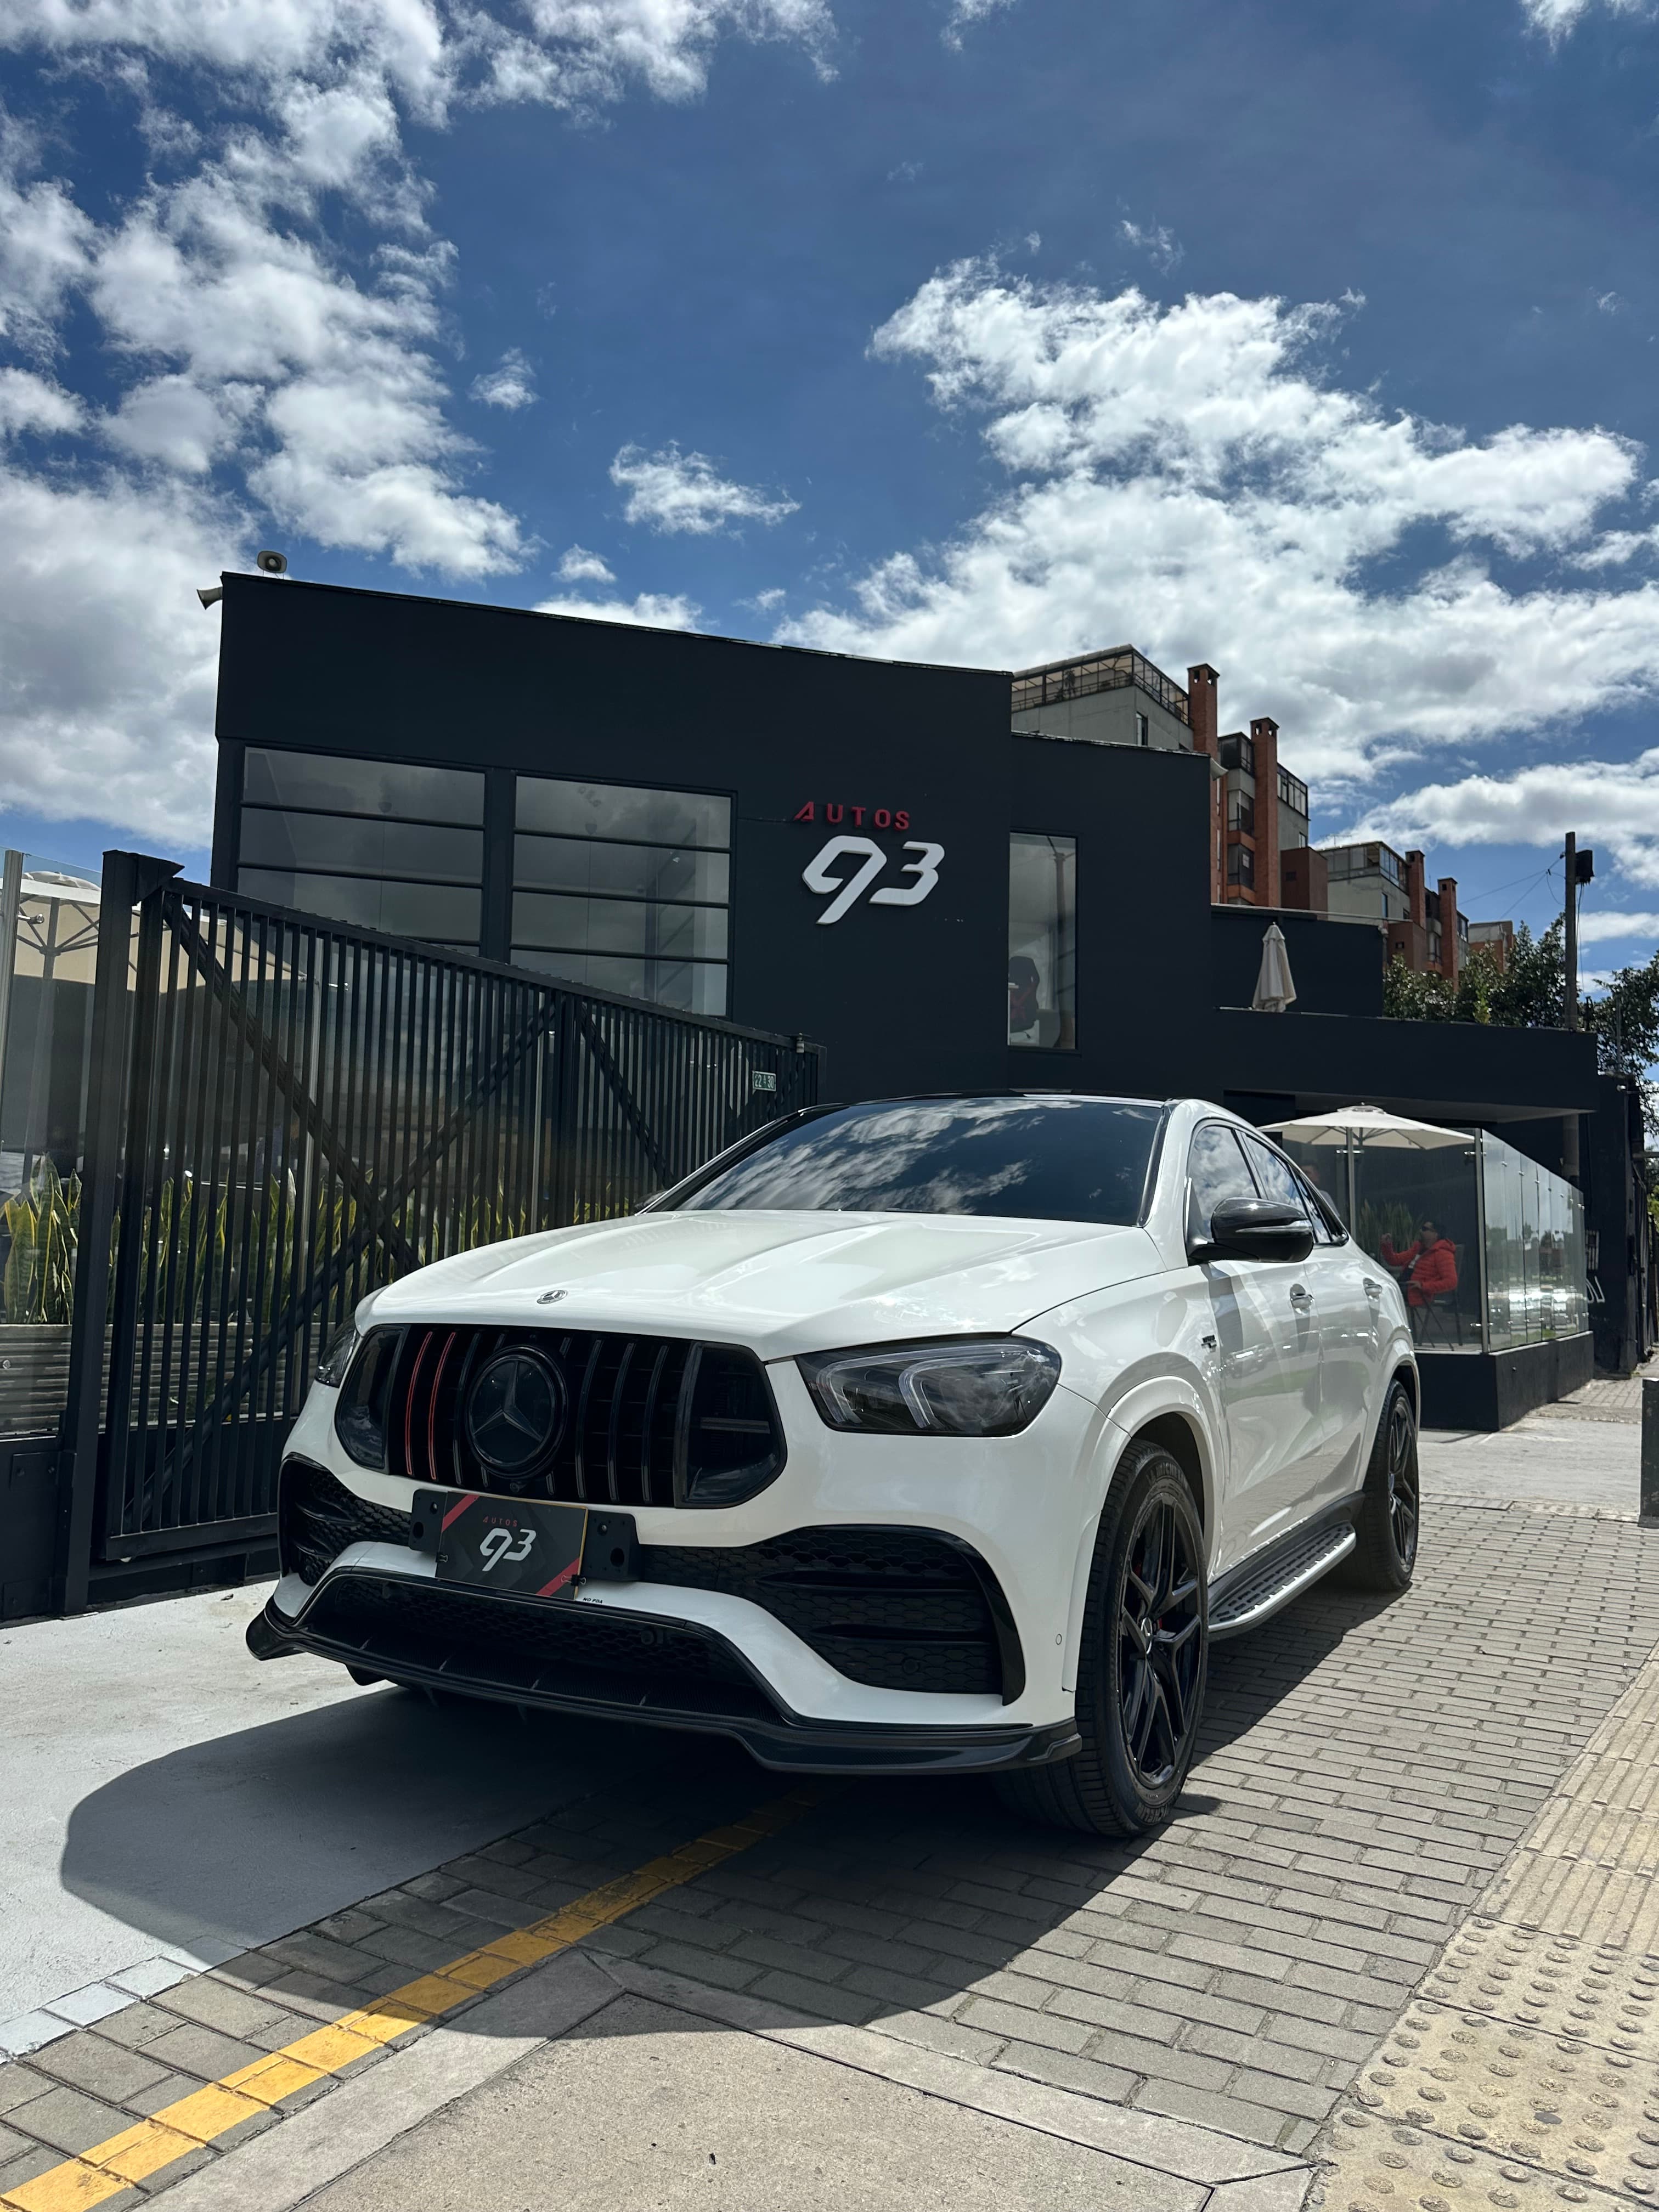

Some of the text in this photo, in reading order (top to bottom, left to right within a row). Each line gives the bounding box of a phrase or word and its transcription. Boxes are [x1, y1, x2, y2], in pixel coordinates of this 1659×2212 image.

[794, 801, 910, 831] AUTOS
[802, 835, 945, 925] 93
[768, 1075, 774, 1089] 30
[483, 1515, 518, 1528] AUTOS
[479, 1527, 537, 1572] 93
